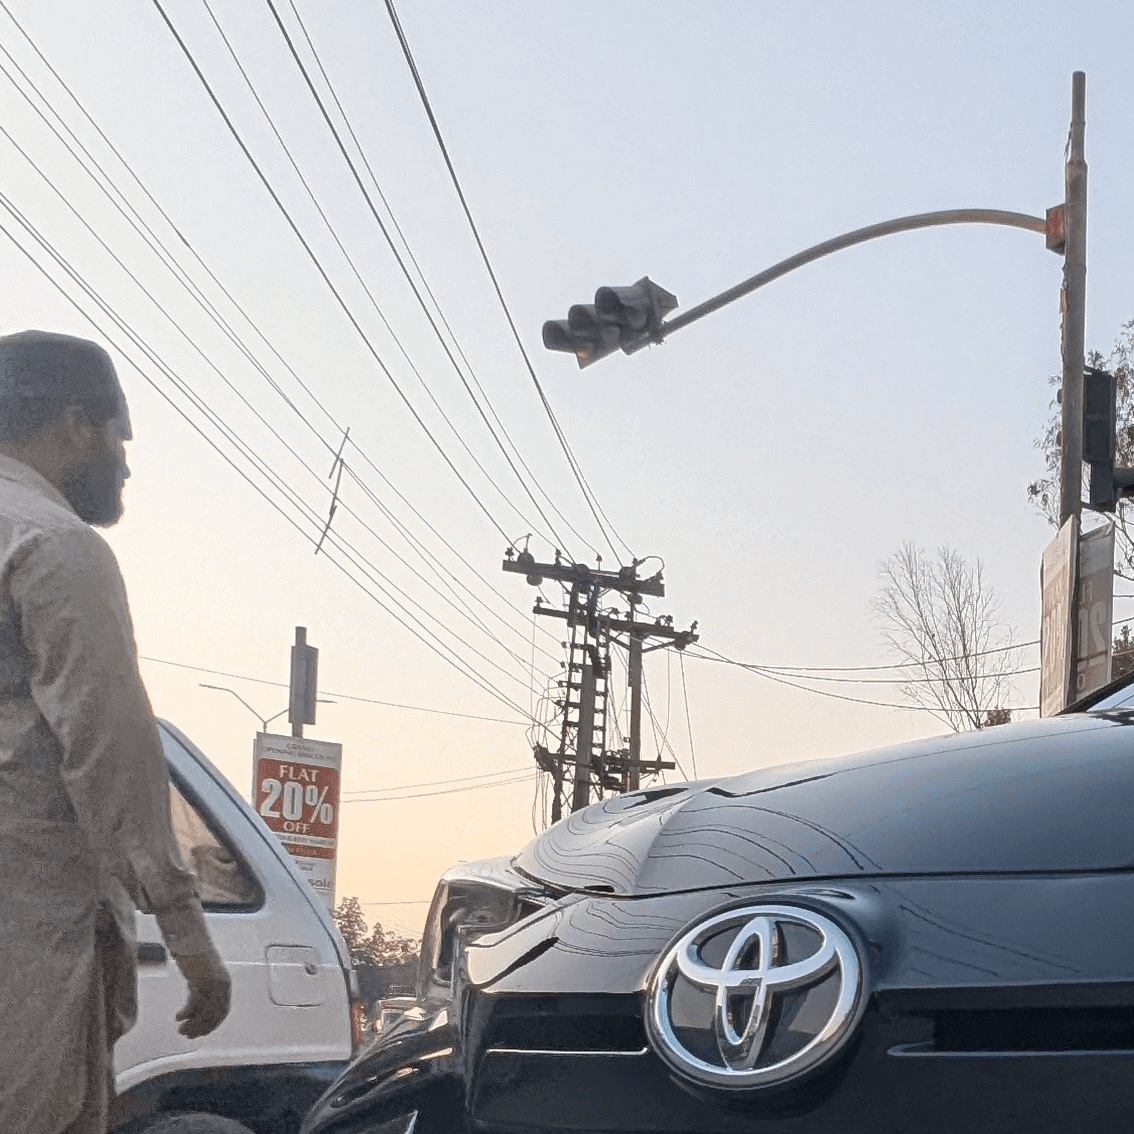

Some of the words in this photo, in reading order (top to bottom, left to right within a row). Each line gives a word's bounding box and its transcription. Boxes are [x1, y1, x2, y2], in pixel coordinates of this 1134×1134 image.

[280, 765, 319, 782] FLAT
[260, 778, 333, 824] 20%
[283, 821, 310, 833] OFF
